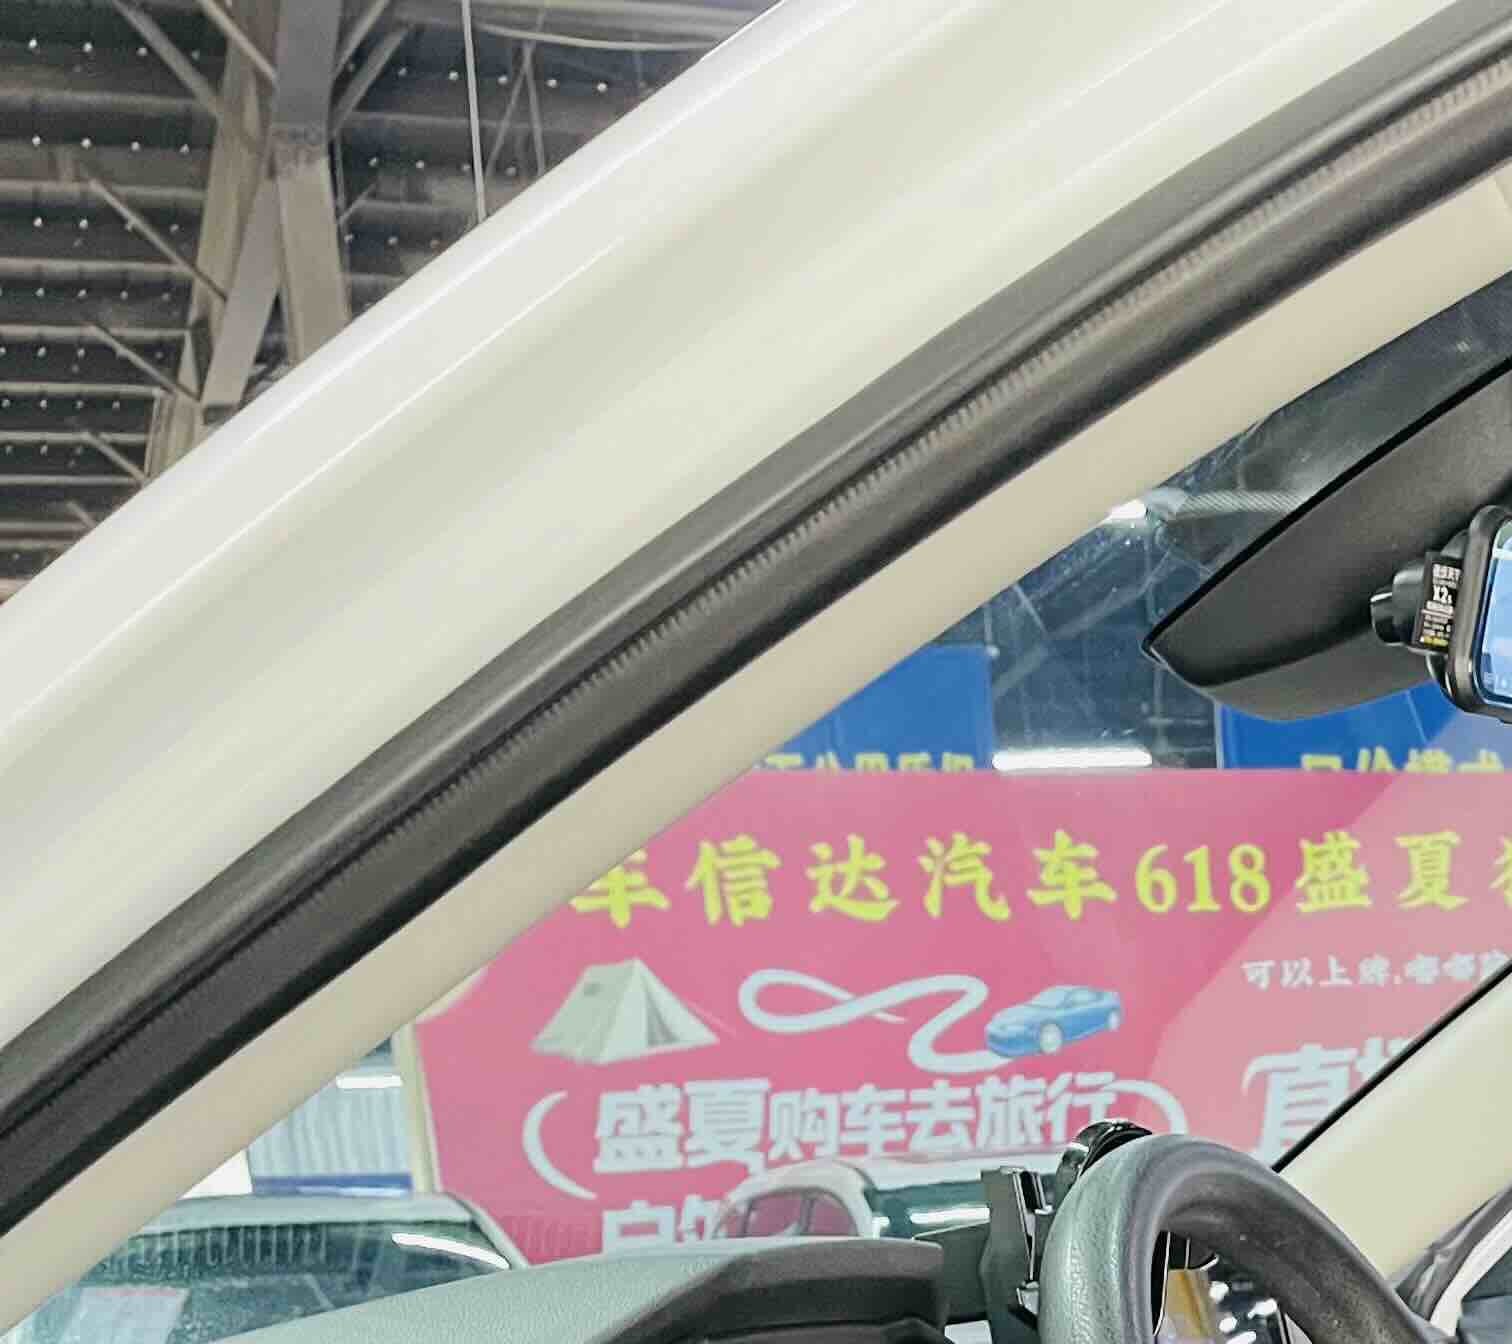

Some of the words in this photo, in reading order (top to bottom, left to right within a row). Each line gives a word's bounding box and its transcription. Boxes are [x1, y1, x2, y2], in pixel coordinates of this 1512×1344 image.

[593, 1071, 1117, 1174] 盛夏购车去旅行
